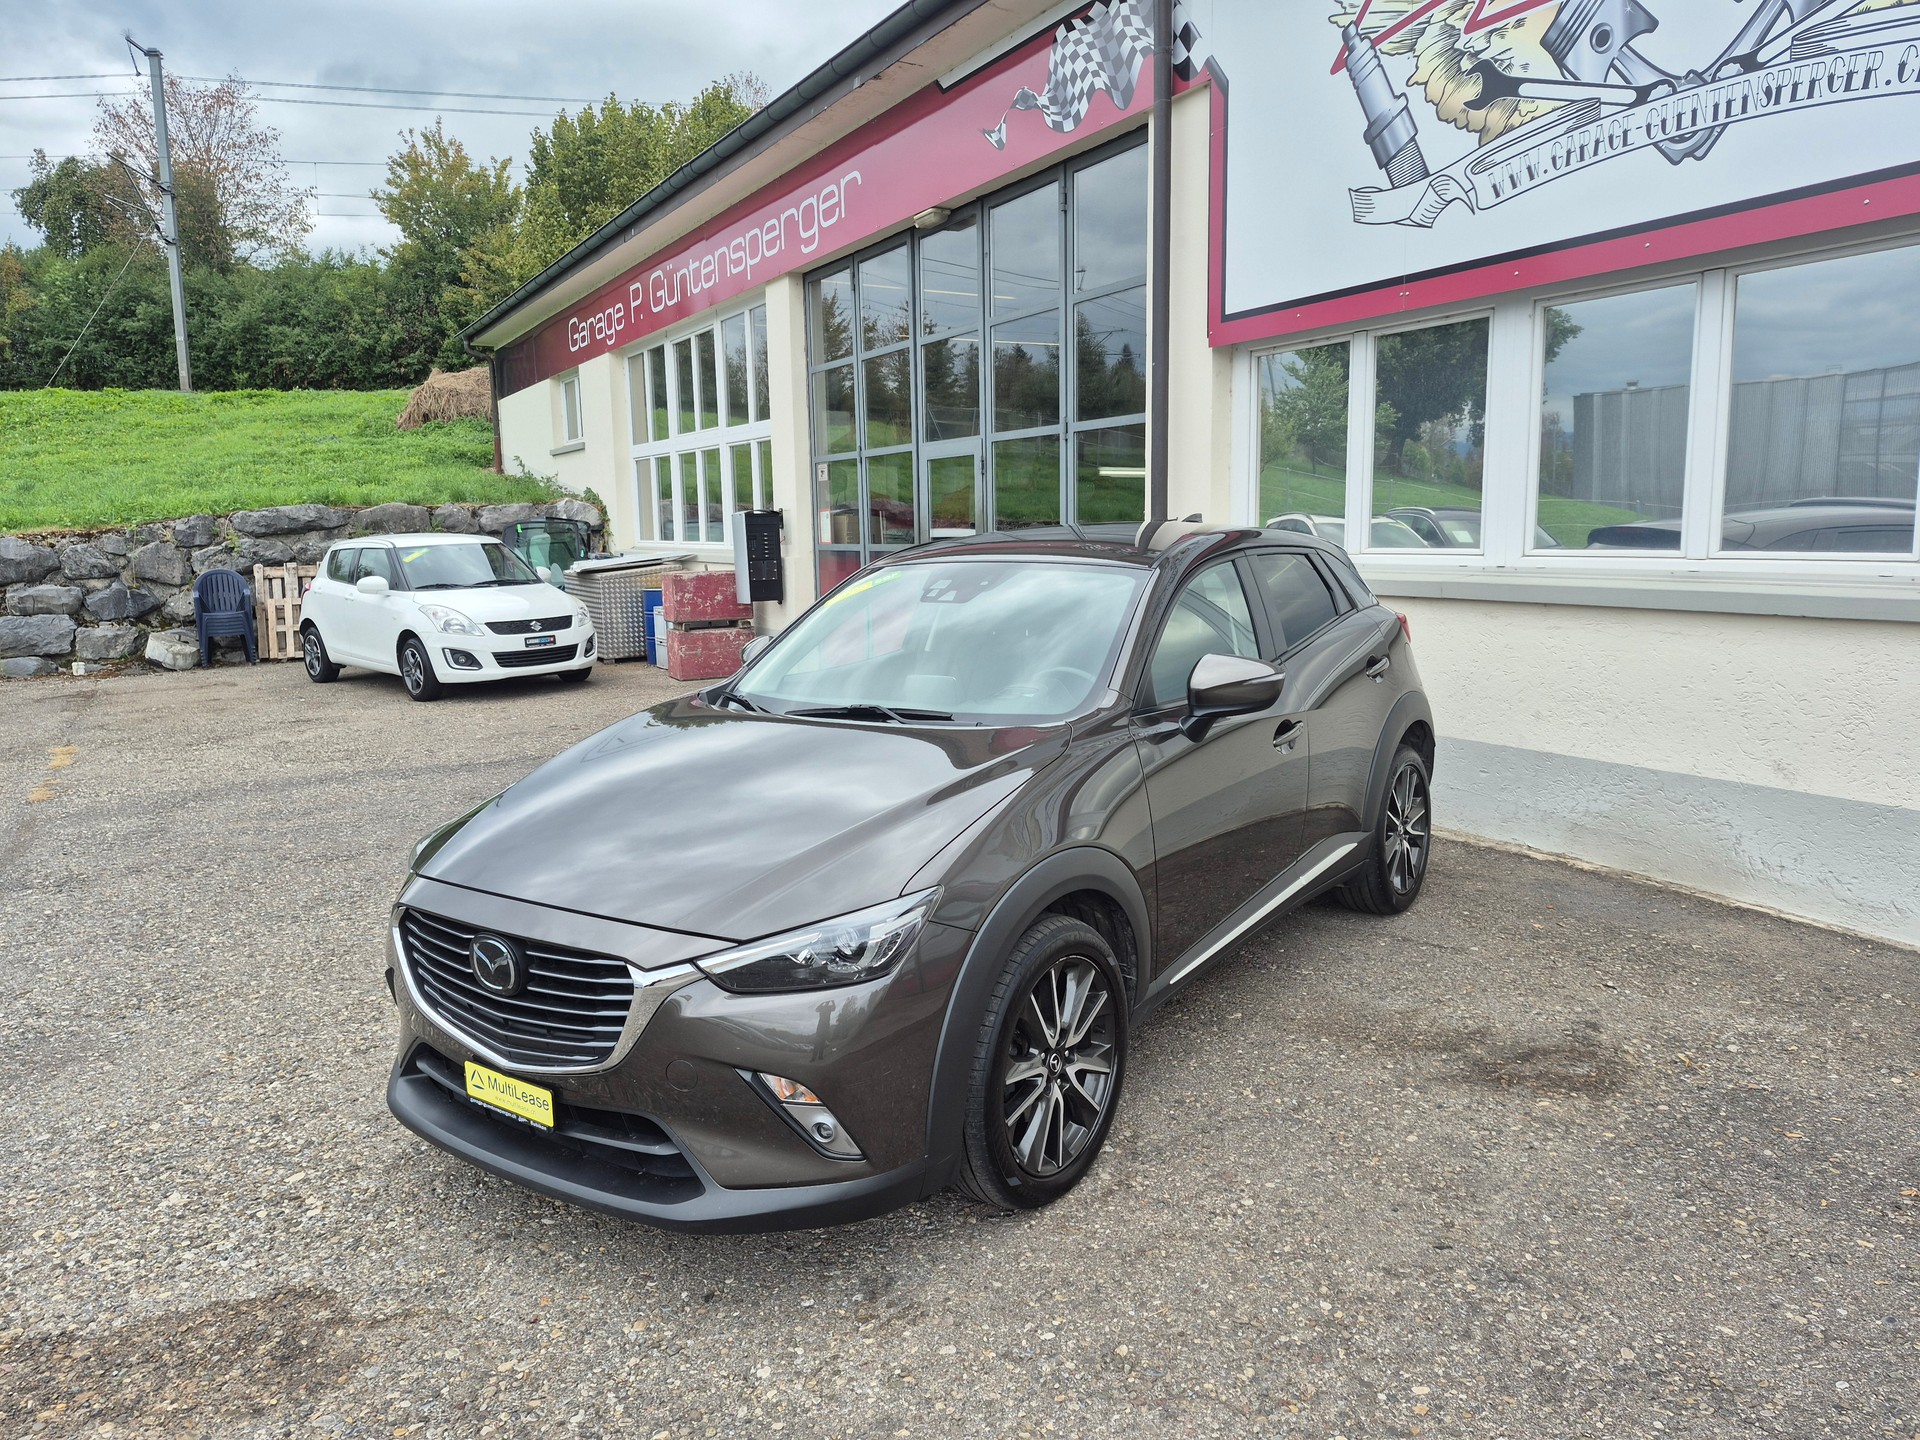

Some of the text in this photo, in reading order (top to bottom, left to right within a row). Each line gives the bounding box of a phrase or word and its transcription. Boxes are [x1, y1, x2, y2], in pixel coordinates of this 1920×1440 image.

[568, 170, 862, 352] Garage P. Güntensperger
[487, 1075, 550, 1111] MultiLease
